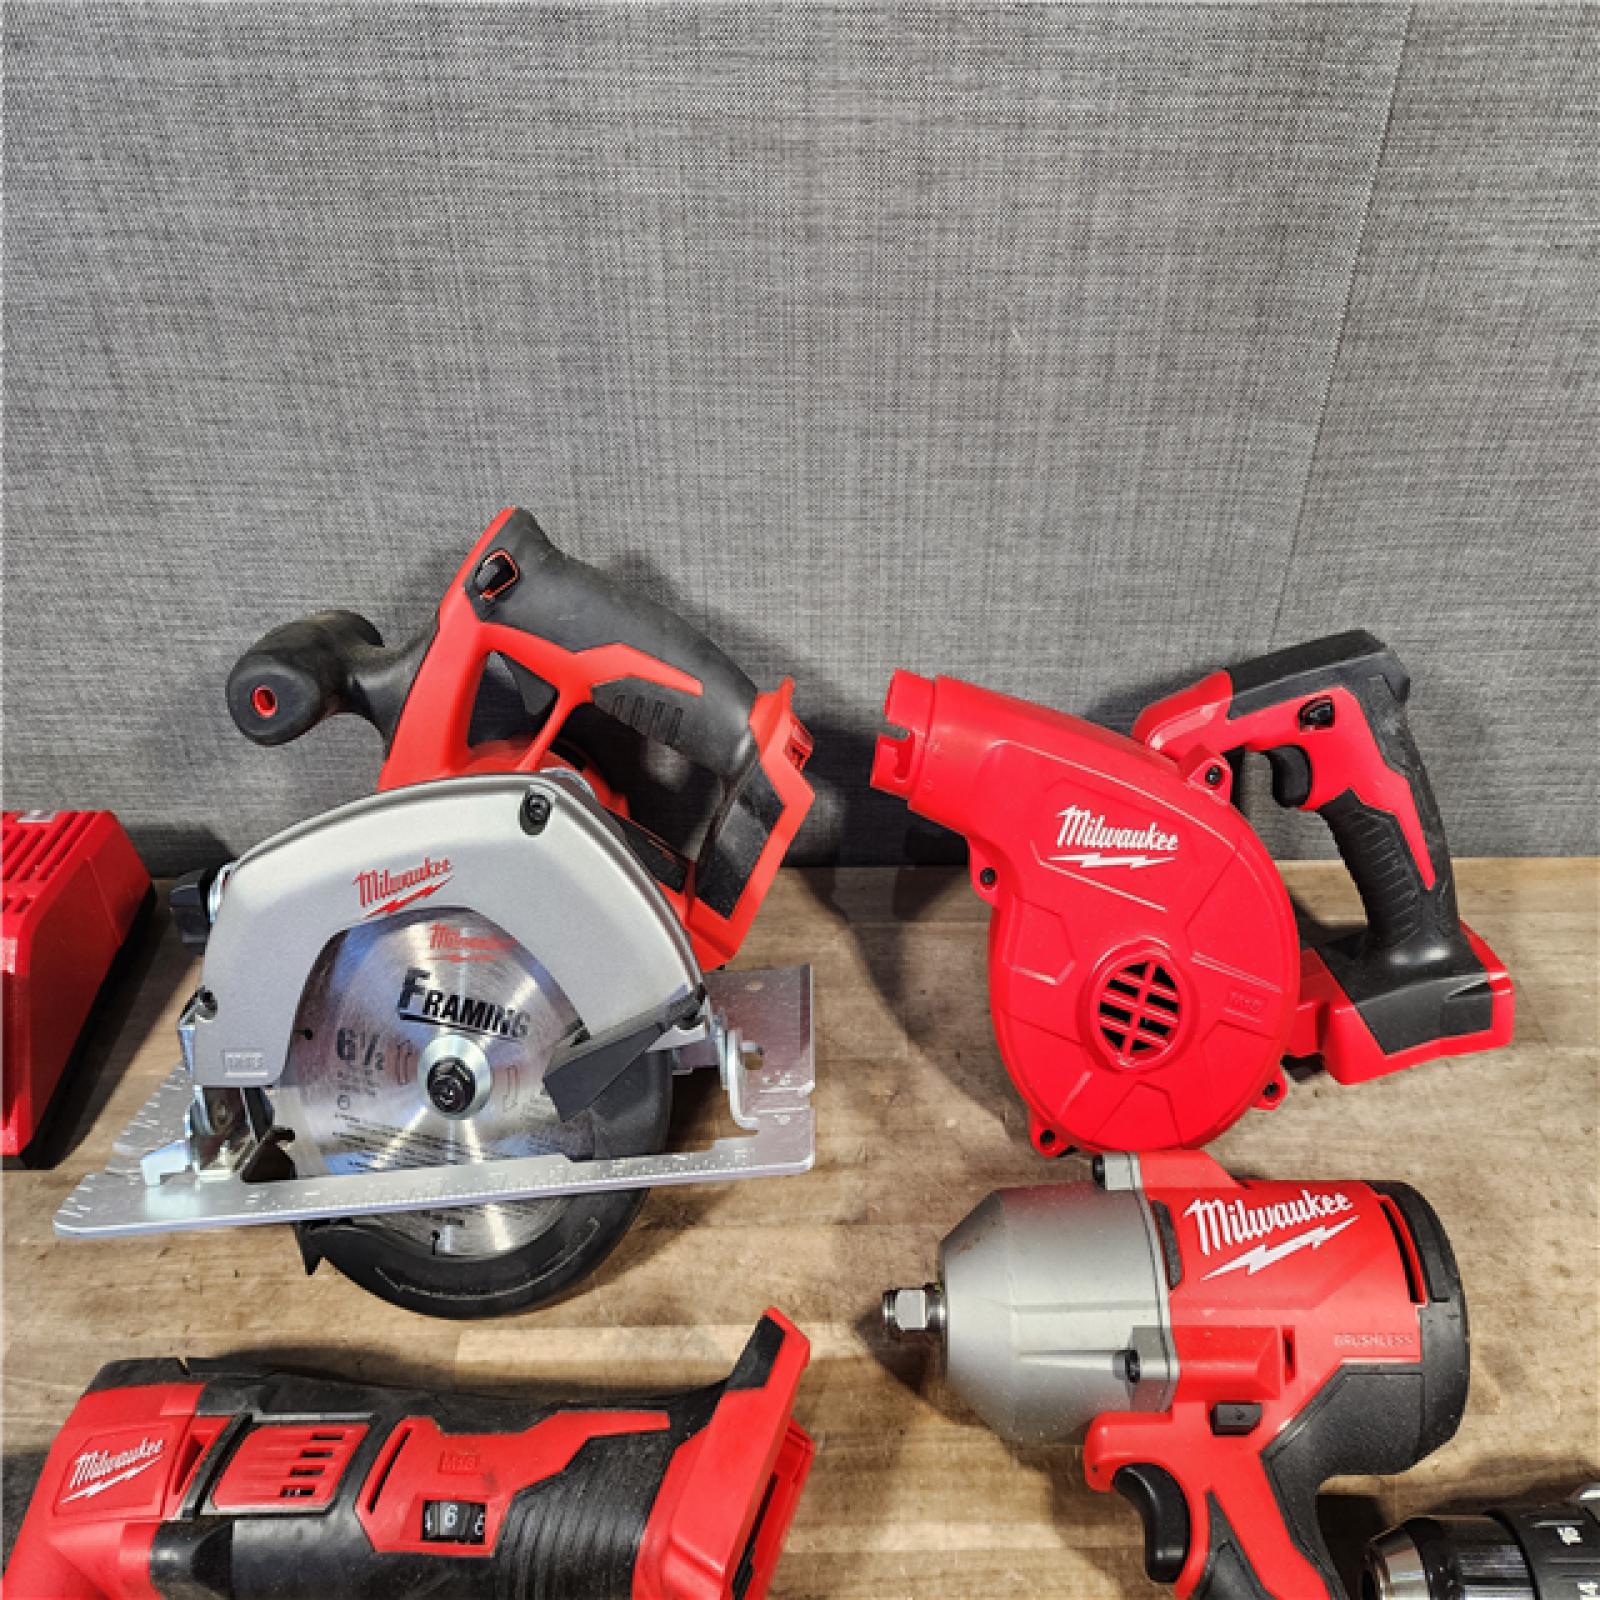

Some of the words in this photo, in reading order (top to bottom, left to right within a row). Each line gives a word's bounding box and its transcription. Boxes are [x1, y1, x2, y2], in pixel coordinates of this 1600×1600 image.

[1057, 804, 1178, 851] Milwaukee
[353, 857, 454, 907] Milwaukee
[397, 968, 530, 1038] FRAMING
[1183, 1190, 1353, 1256] Milwaukee
[70, 1437, 163, 1489] Milwaukee
[445, 1504, 458, 1529] 6
